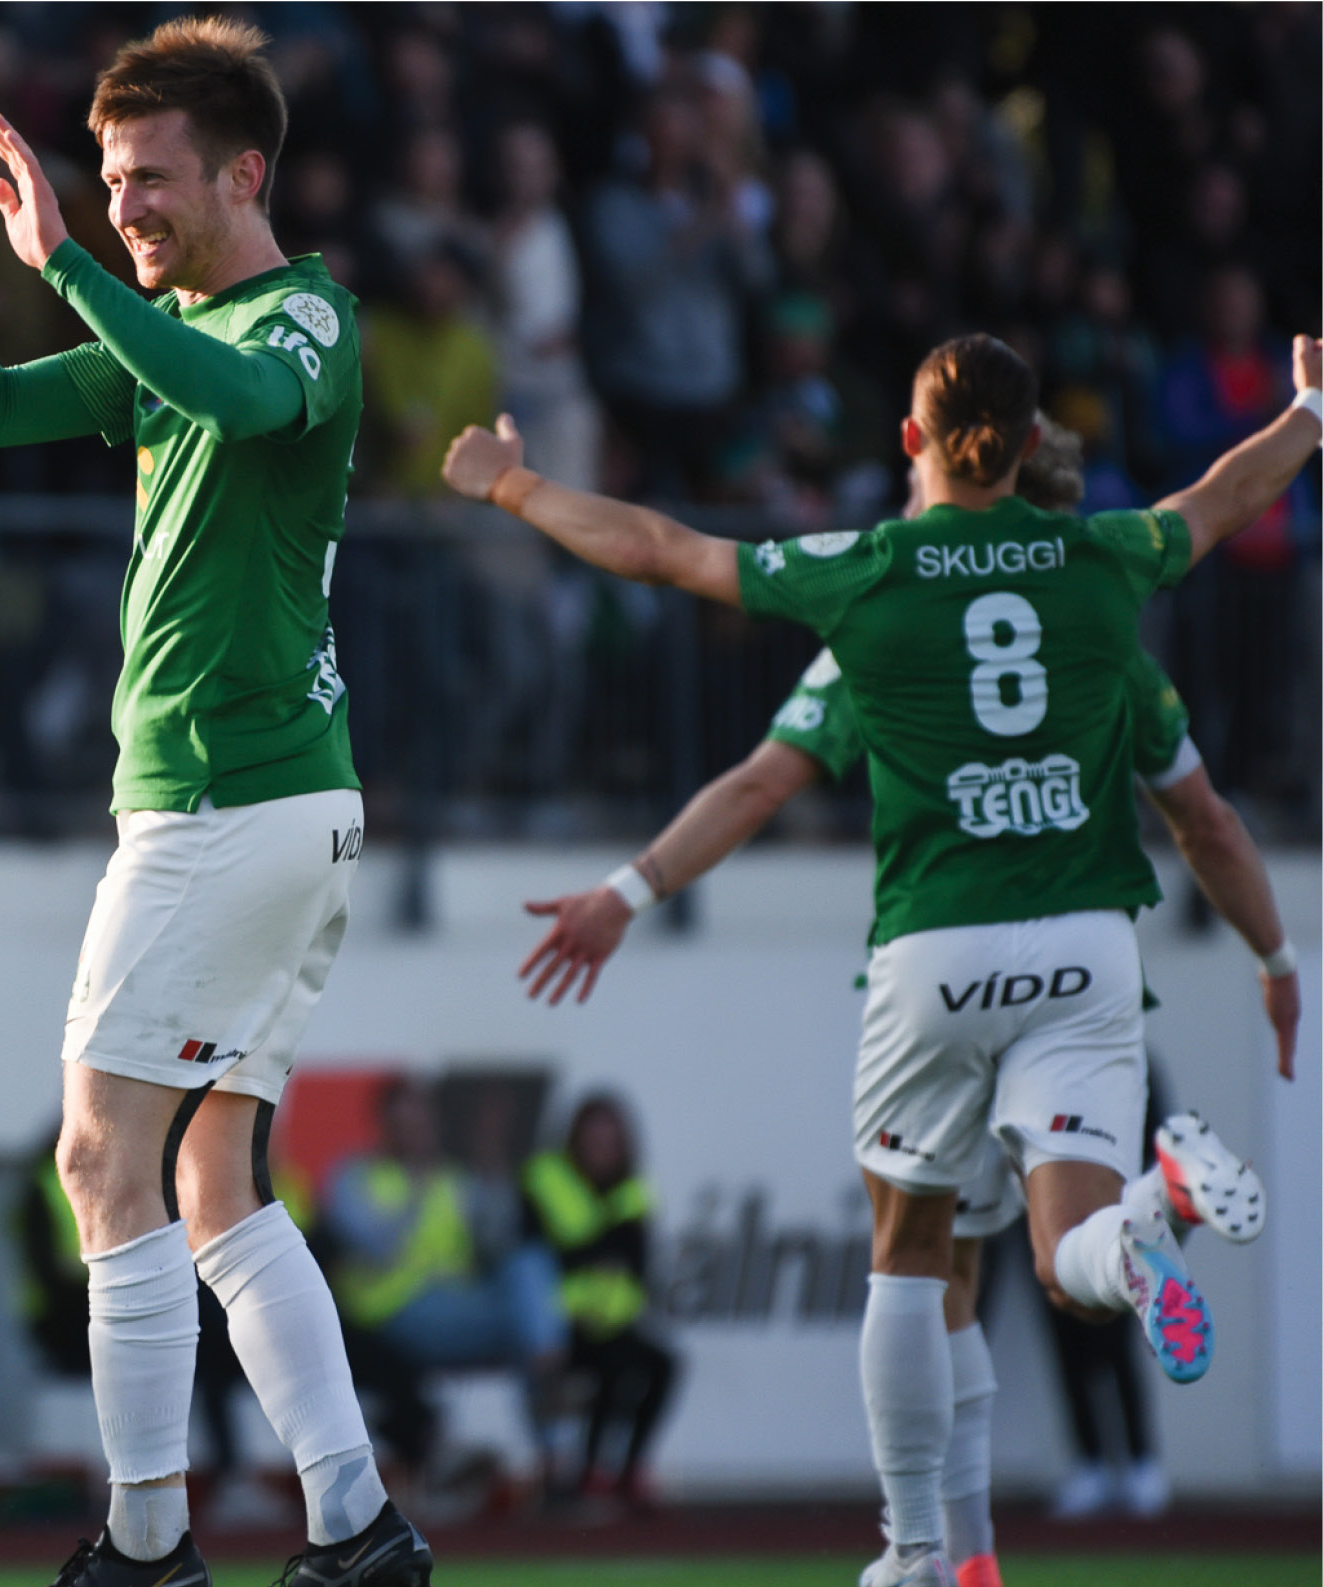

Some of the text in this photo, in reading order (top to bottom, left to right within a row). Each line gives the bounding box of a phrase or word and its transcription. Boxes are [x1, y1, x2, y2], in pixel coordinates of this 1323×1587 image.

[916, 536, 1066, 579] SKUGGI
[964, 591, 1049, 737] 8
[947, 773, 1086, 829] TENGI
[331, 818, 364, 865] VÍD
[939, 965, 1093, 1013] VÍDD
